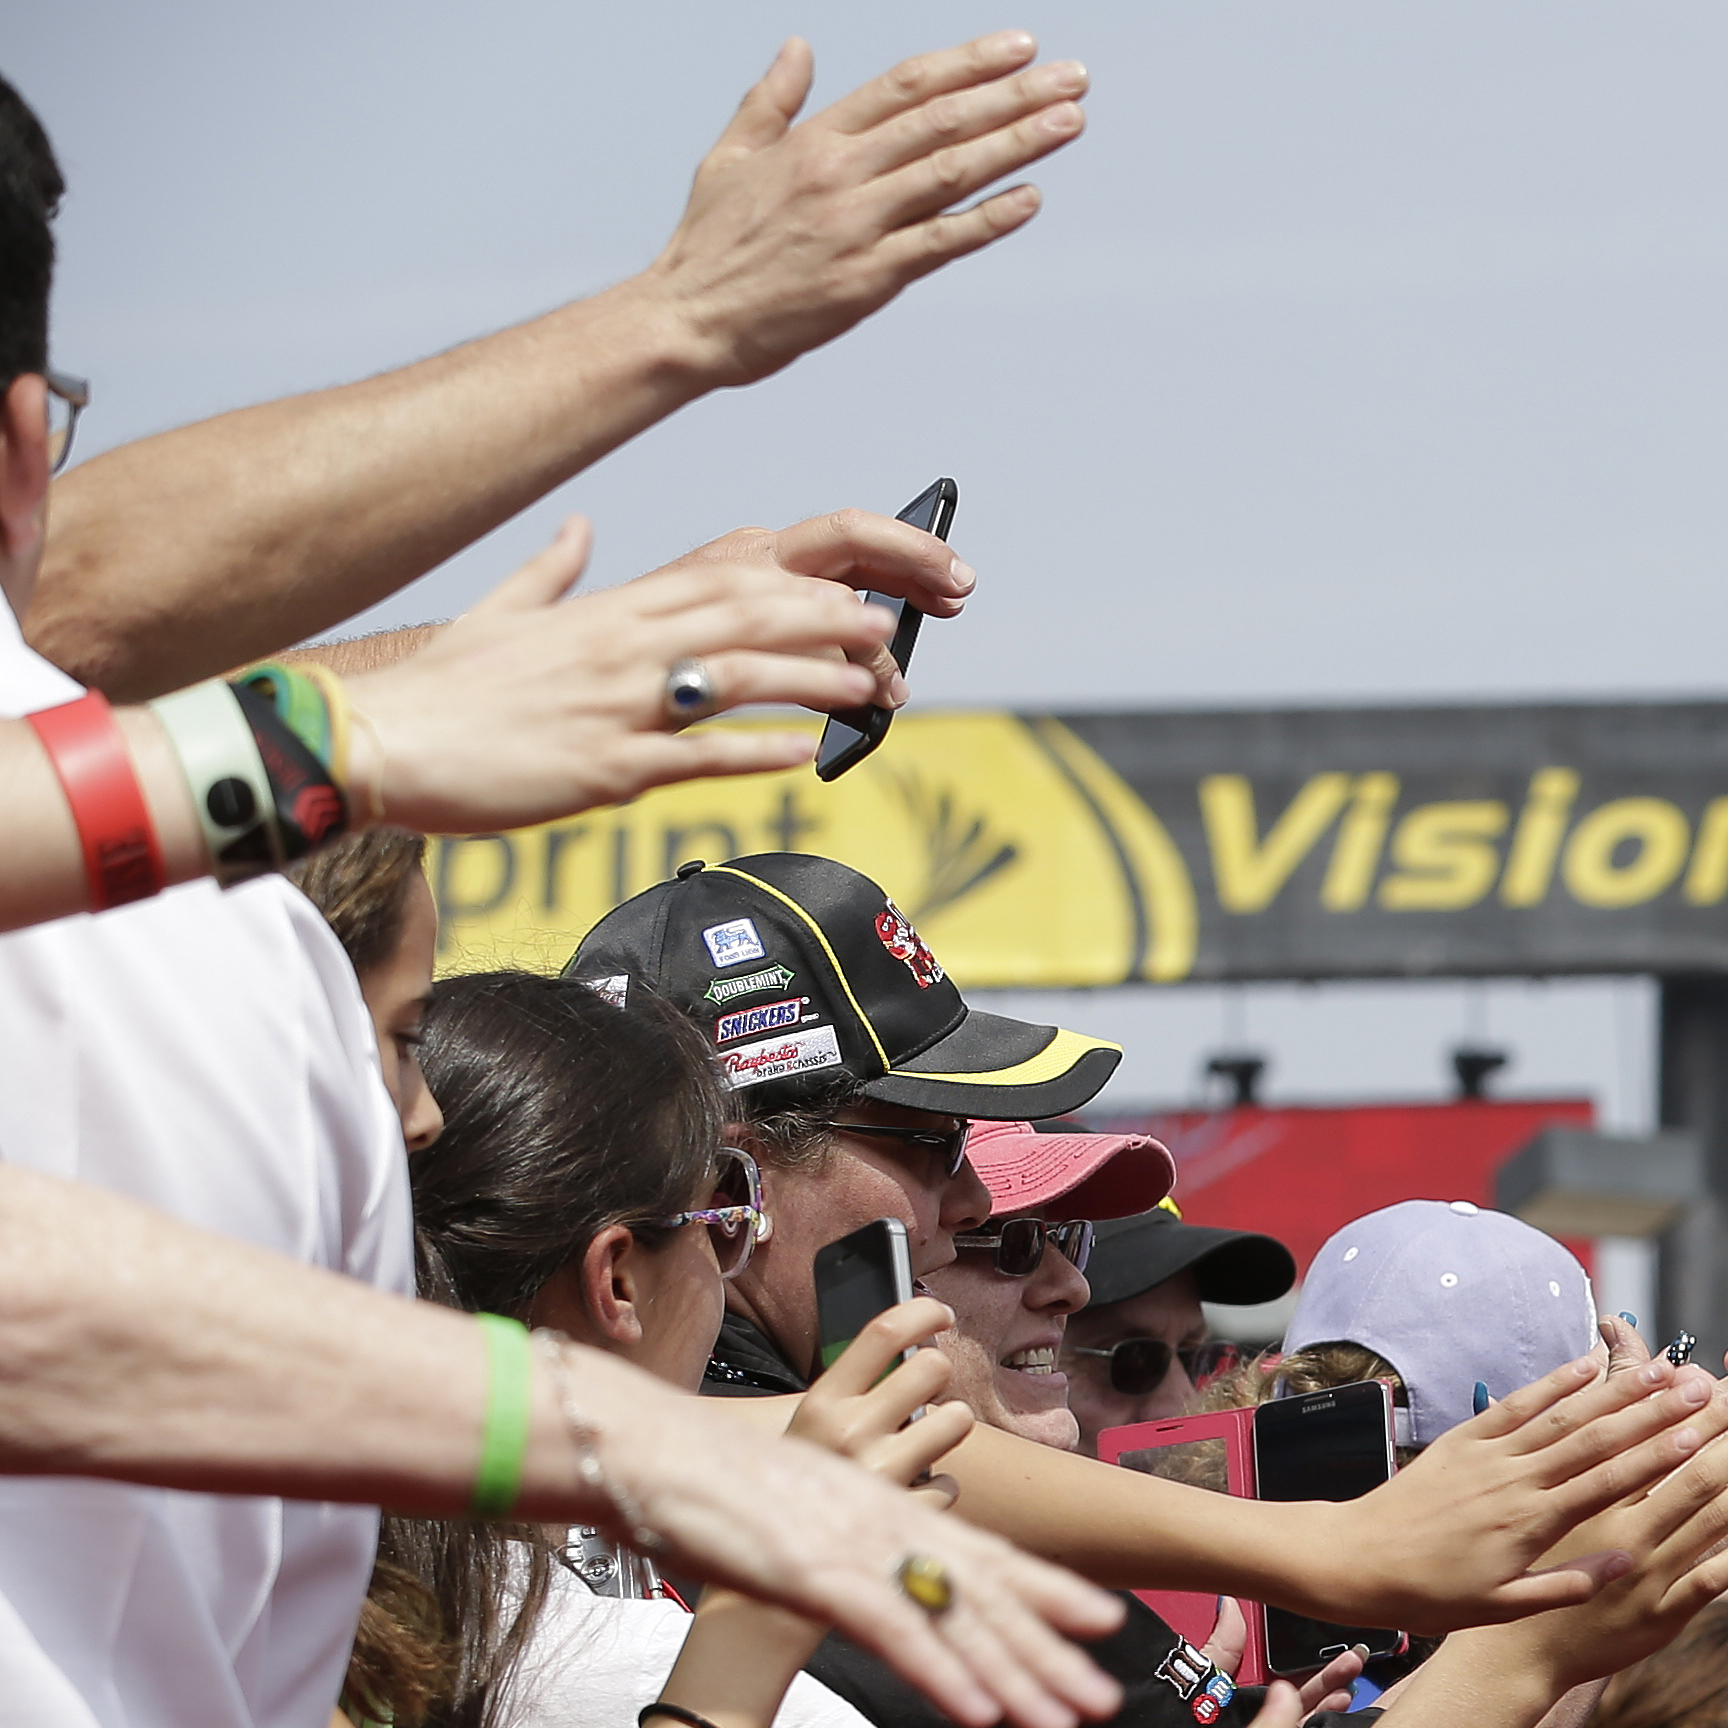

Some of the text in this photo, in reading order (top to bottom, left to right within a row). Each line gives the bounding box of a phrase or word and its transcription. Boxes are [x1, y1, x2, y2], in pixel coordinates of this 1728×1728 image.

[430, 780, 824, 952] print
[712, 969, 785, 1000] DOUBLEMINT
[720, 1003, 796, 1040] SNICKERS
